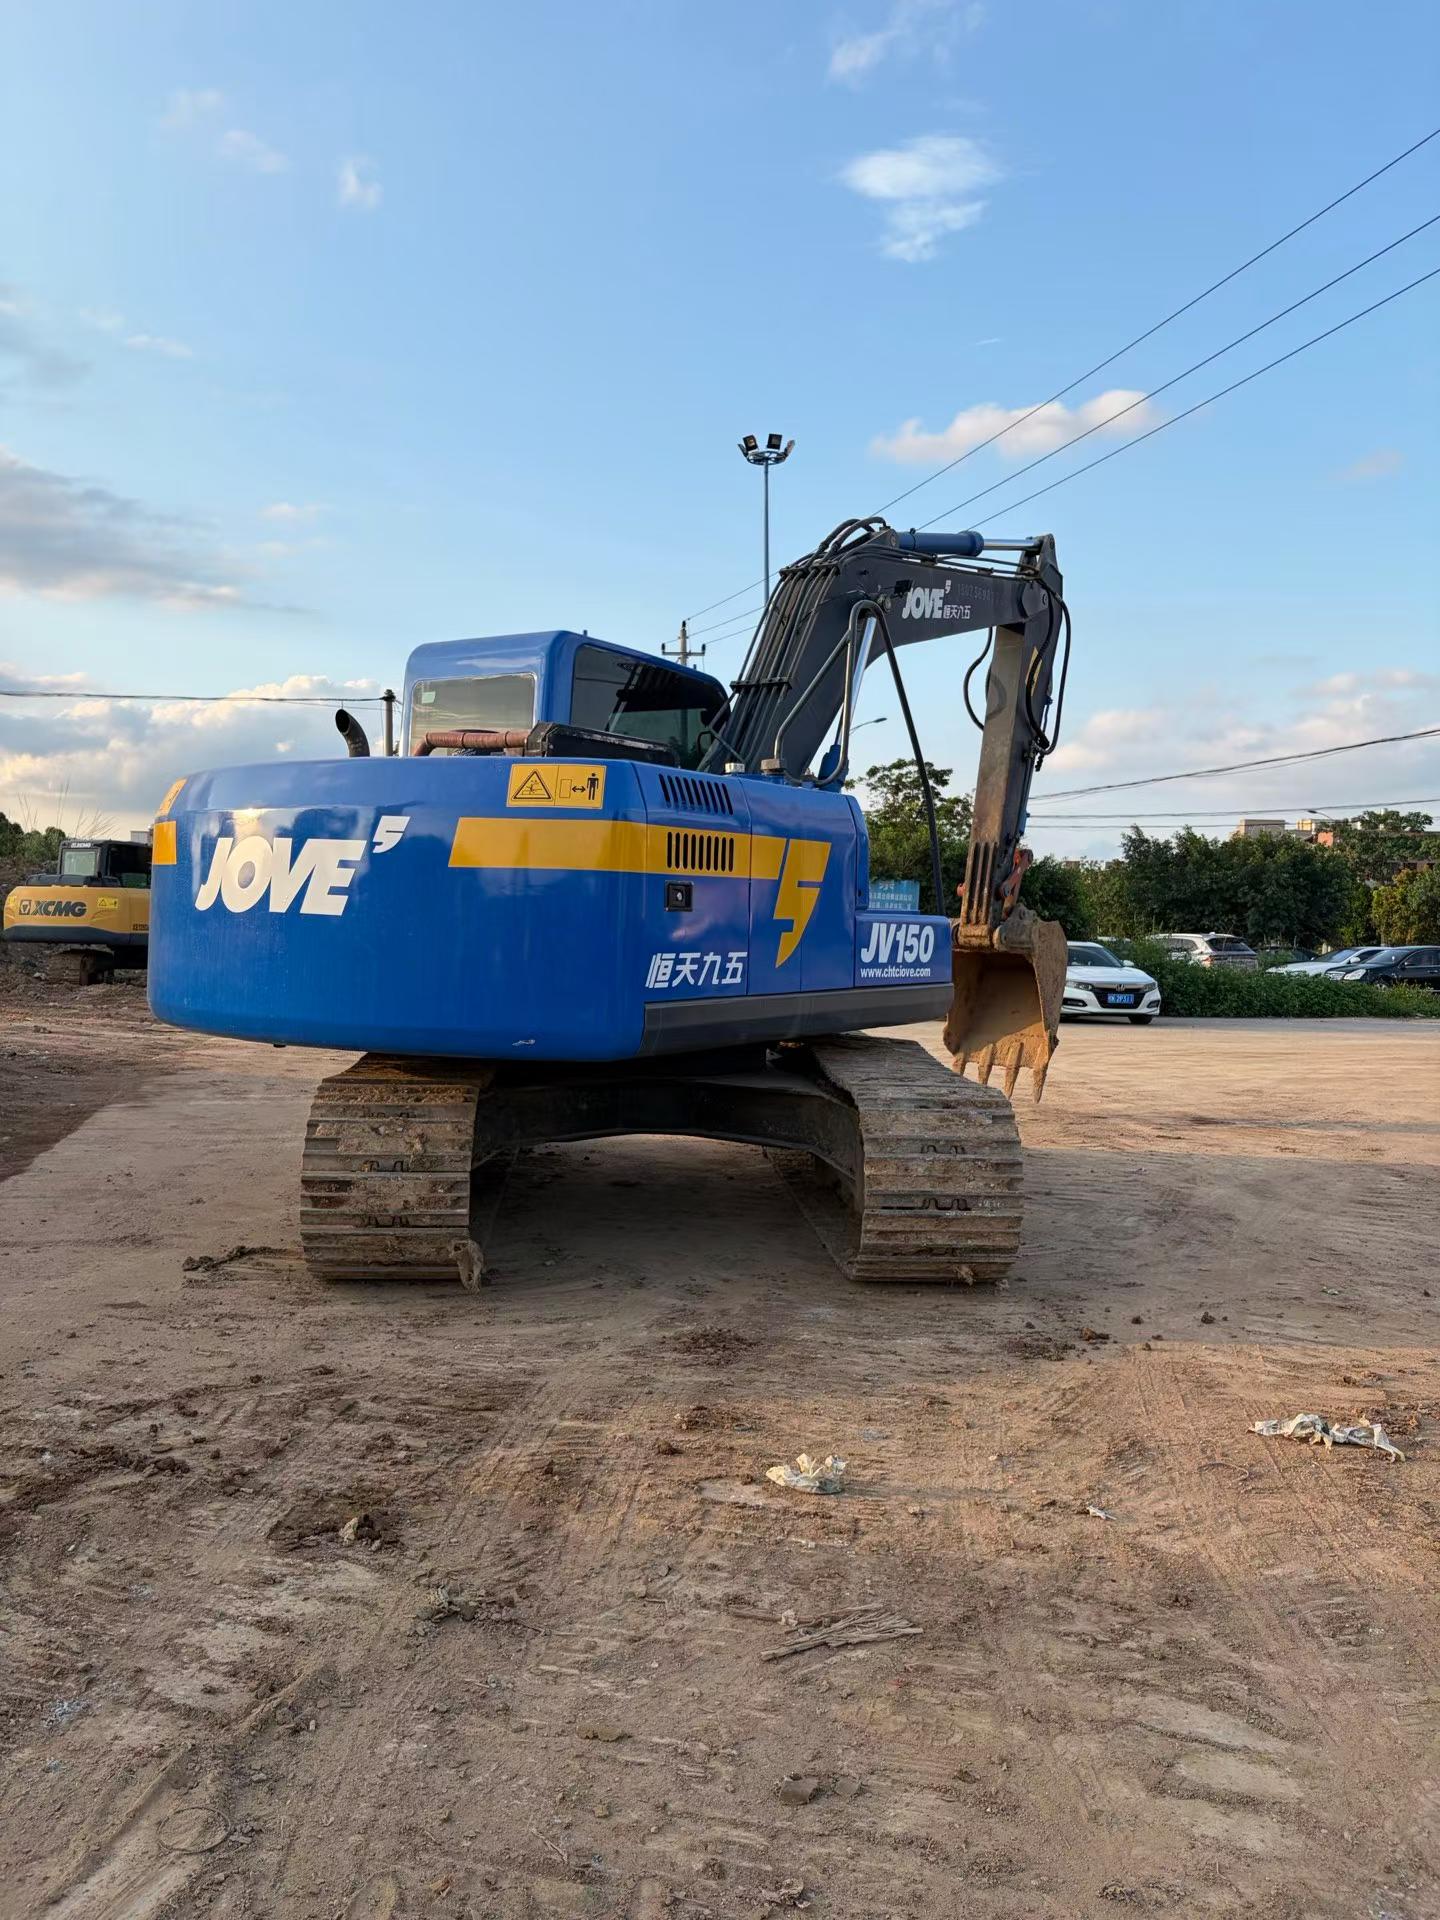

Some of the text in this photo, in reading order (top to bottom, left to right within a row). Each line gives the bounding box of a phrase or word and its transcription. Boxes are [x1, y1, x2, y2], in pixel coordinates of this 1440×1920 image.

[902, 587, 945, 619] JOVE
[194, 835, 367, 916] JOVE
[31, 901, 87, 917] XCMG
[861, 922, 935, 963] JV150
[645, 952, 748, 988] 恒天九五
